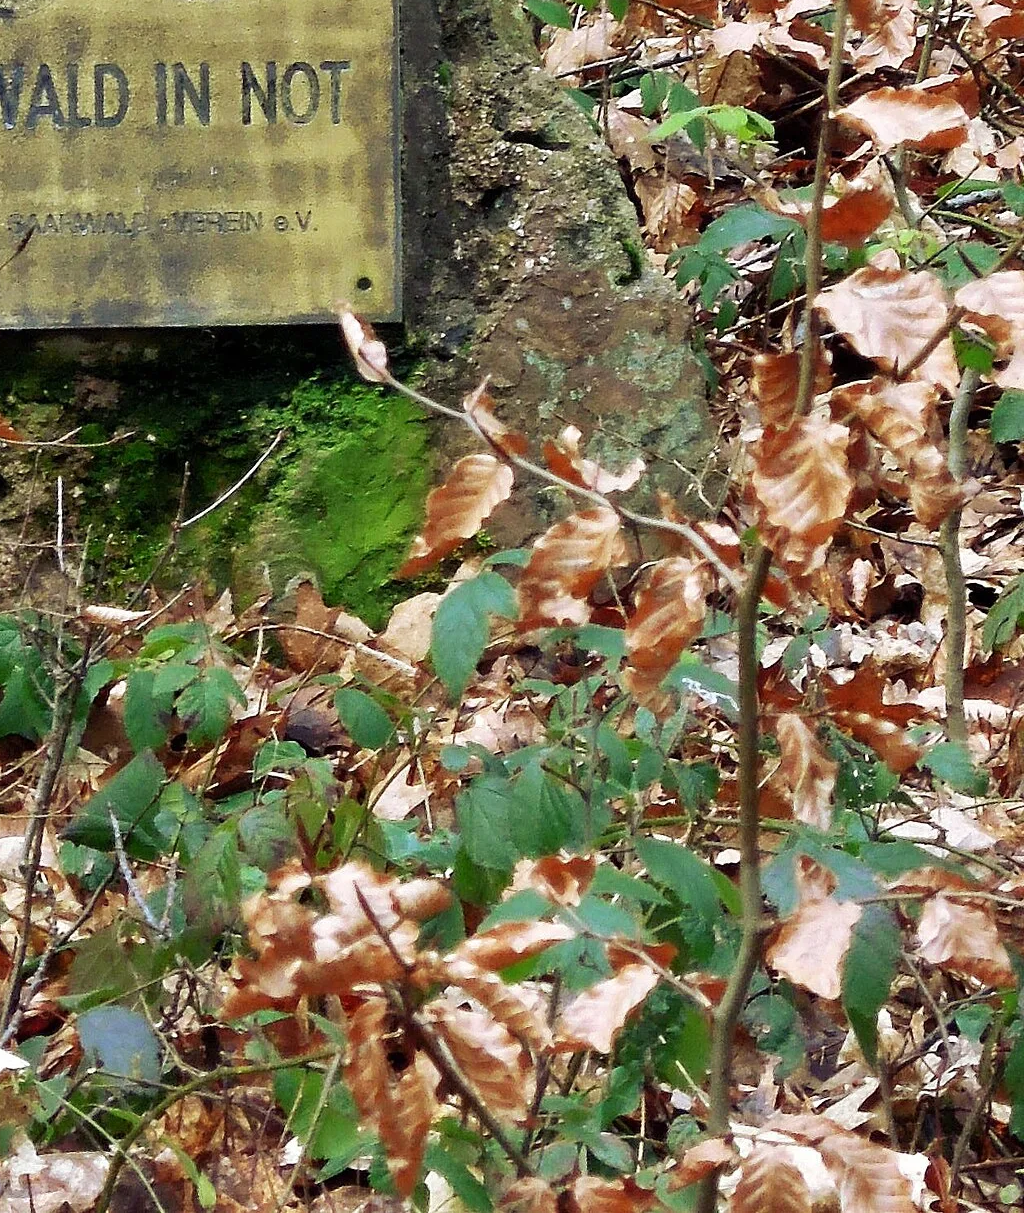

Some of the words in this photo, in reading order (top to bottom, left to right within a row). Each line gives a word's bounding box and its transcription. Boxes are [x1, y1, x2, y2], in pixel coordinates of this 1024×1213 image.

[156, 62, 210, 126] IN
[241, 60, 351, 125] NOT
[274, 210, 318, 233] e.V.
